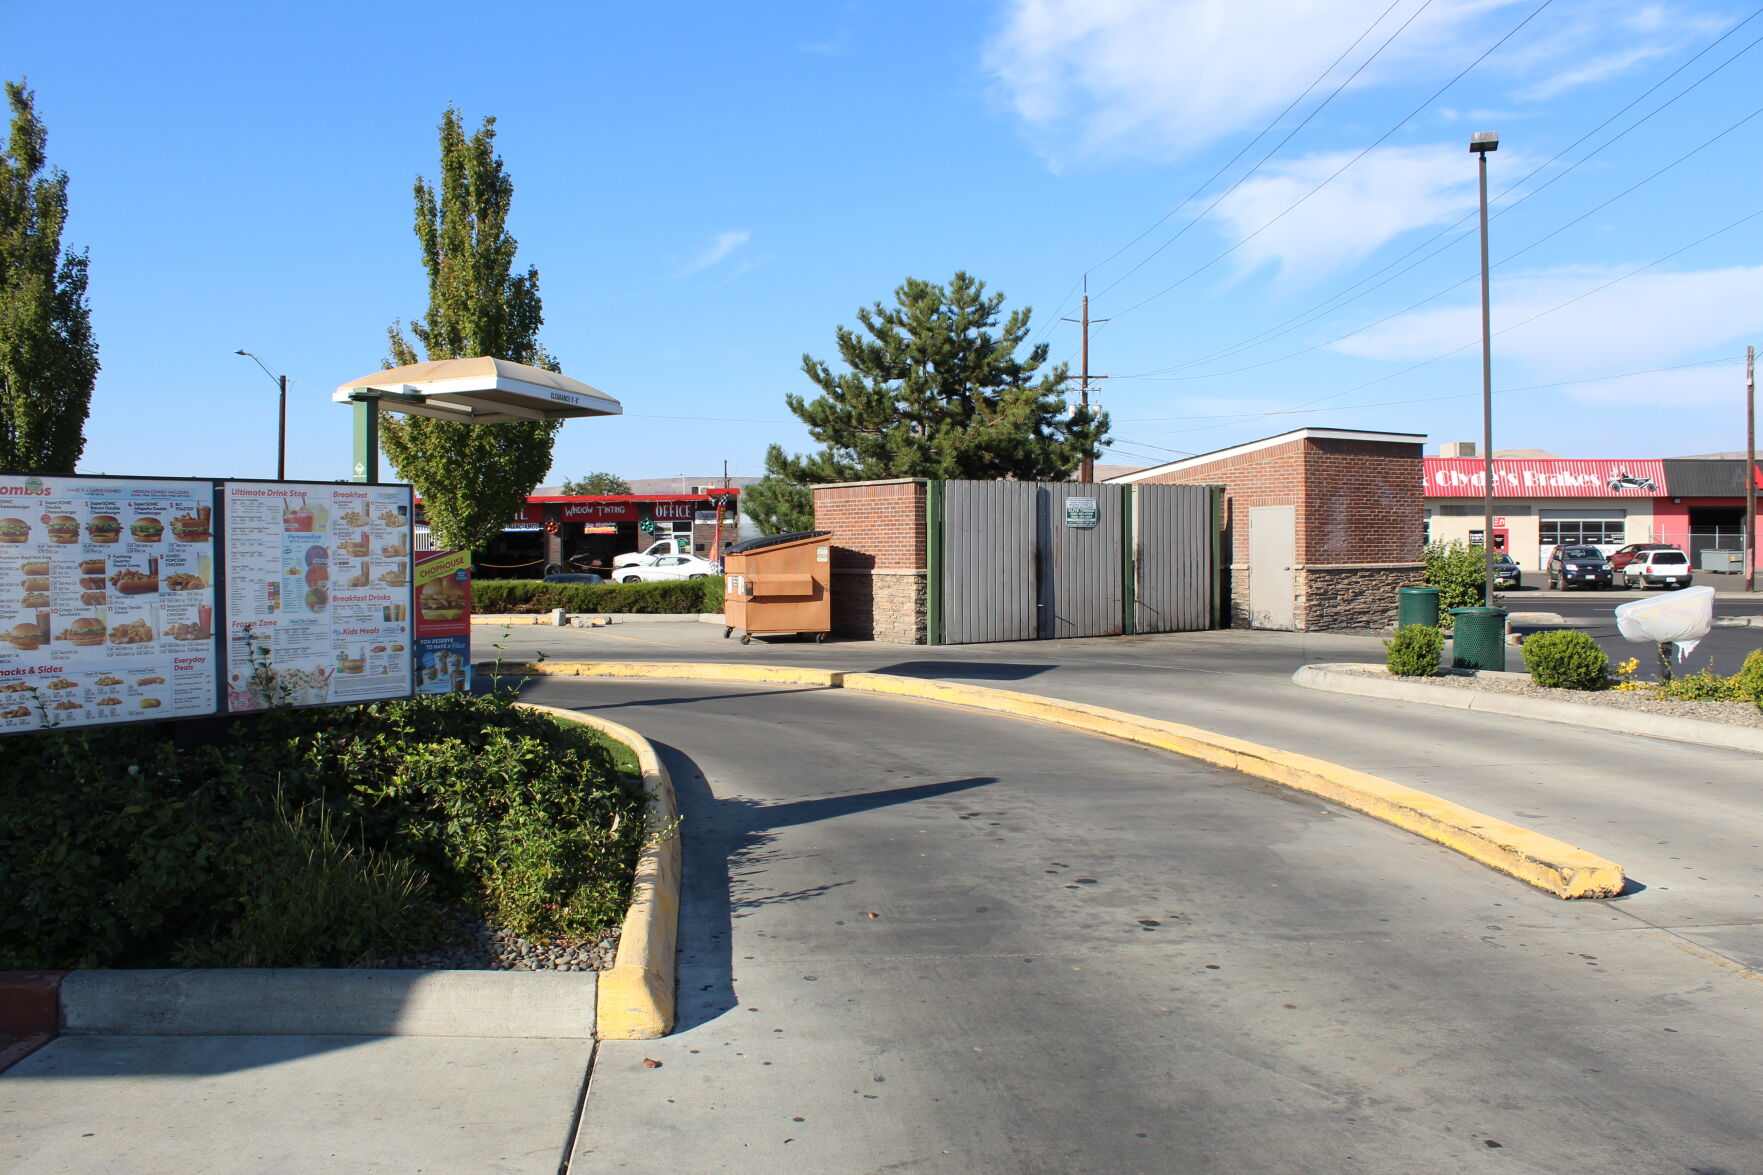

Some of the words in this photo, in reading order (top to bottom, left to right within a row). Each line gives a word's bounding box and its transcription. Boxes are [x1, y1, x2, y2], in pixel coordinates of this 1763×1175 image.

[1523, 470, 1601, 487] Brakes
[289, 490, 308, 498] Stop
[333, 491, 368, 499] Breakfast
[564, 504, 593, 517] WINDOW
[655, 504, 692, 518] OFFICE
[420, 556, 465, 578] CHOPHOUSE
[174, 656, 206, 664] Everyday
[28, 666, 36, 675] &
[38, 665, 63, 674] Sides
